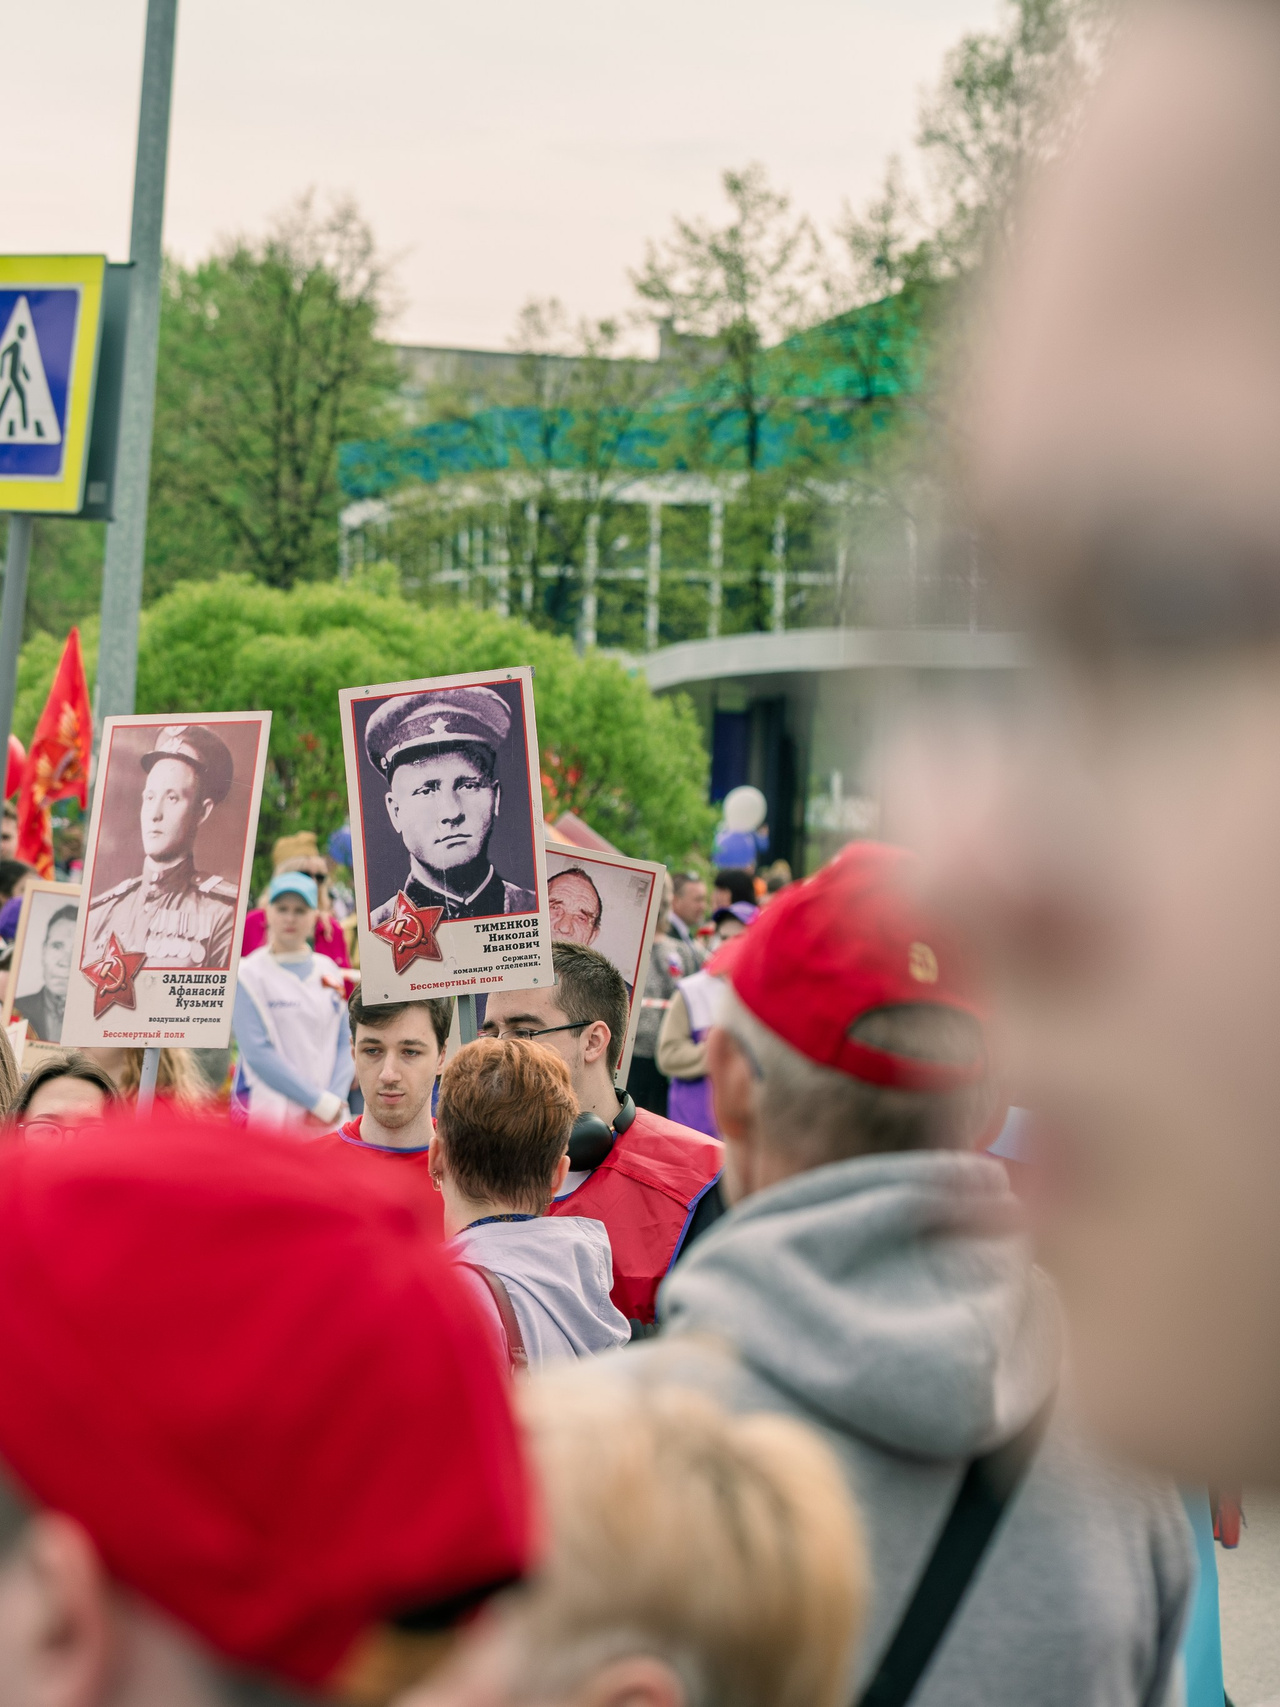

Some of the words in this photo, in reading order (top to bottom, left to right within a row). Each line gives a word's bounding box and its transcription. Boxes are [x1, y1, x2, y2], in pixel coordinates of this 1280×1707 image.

[473, 918, 539, 934] ТИМЕНКОВ
[488, 928, 540, 943] Николай
[482, 940, 541, 954] Иванович
[502, 953, 541, 963] Сержант,
[453, 965, 494, 975] командир
[495, 961, 541, 970] отделения.
[162, 974, 227, 984] ЗАЛАШКОВ
[409, 978, 477, 992] Бессмертный
[480, 975, 504, 984] полк
[168, 985, 226, 998] Афанасий
[175, 997, 224, 1010] Кузьмич
[148, 1016, 190, 1024] воздушный
[102, 1030, 161, 1040] Бессмертный
